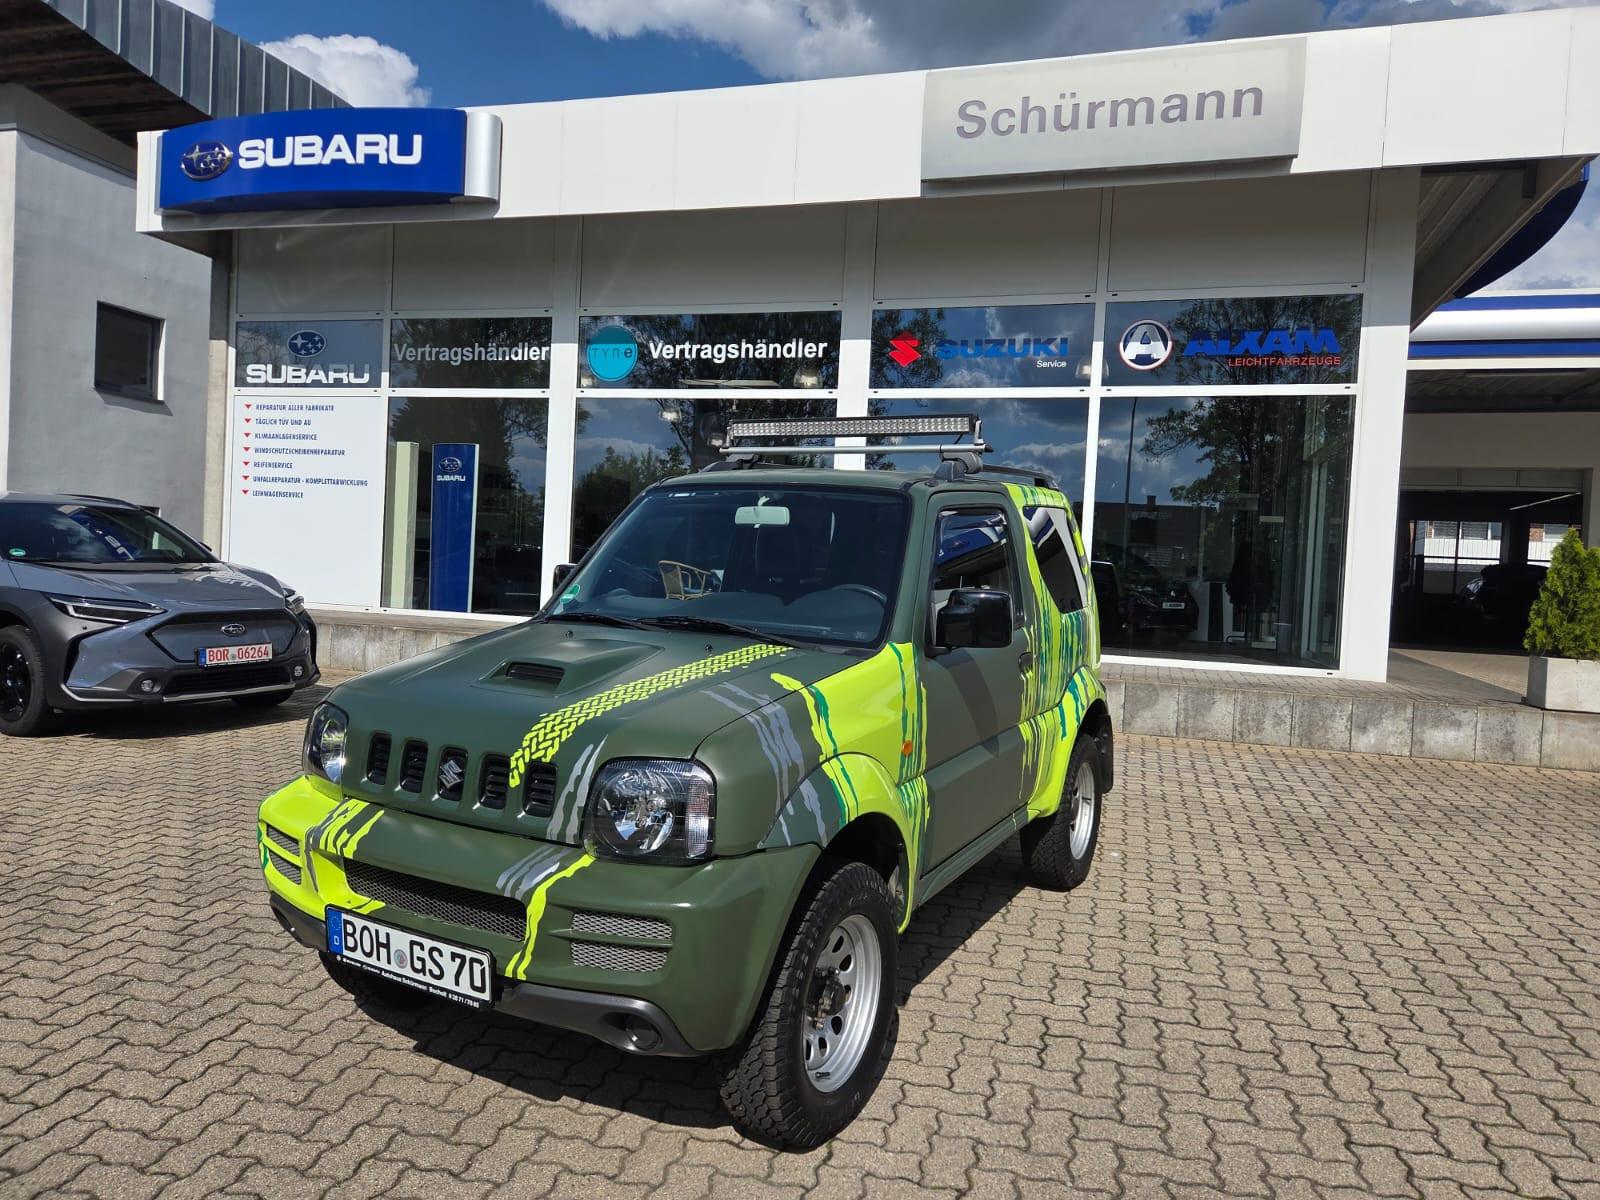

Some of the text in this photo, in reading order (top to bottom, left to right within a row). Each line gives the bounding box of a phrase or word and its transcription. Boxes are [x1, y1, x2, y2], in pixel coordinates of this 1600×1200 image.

[955, 84, 1264, 140] Schürmann
[238, 134, 423, 170] SUBARU
[394, 342, 550, 367] Vertragshändler
[650, 338, 828, 364] Vertragshändler
[936, 337, 1069, 359] SUZUKI
[246, 363, 370, 384] SUBARU
[1036, 360, 1067, 368] Service
[1228, 356, 1342, 368] LEICHTFAHRZEUGE
[208, 646, 270, 662] BOR 06264
[342, 918, 487, 994] BOH GS 70
